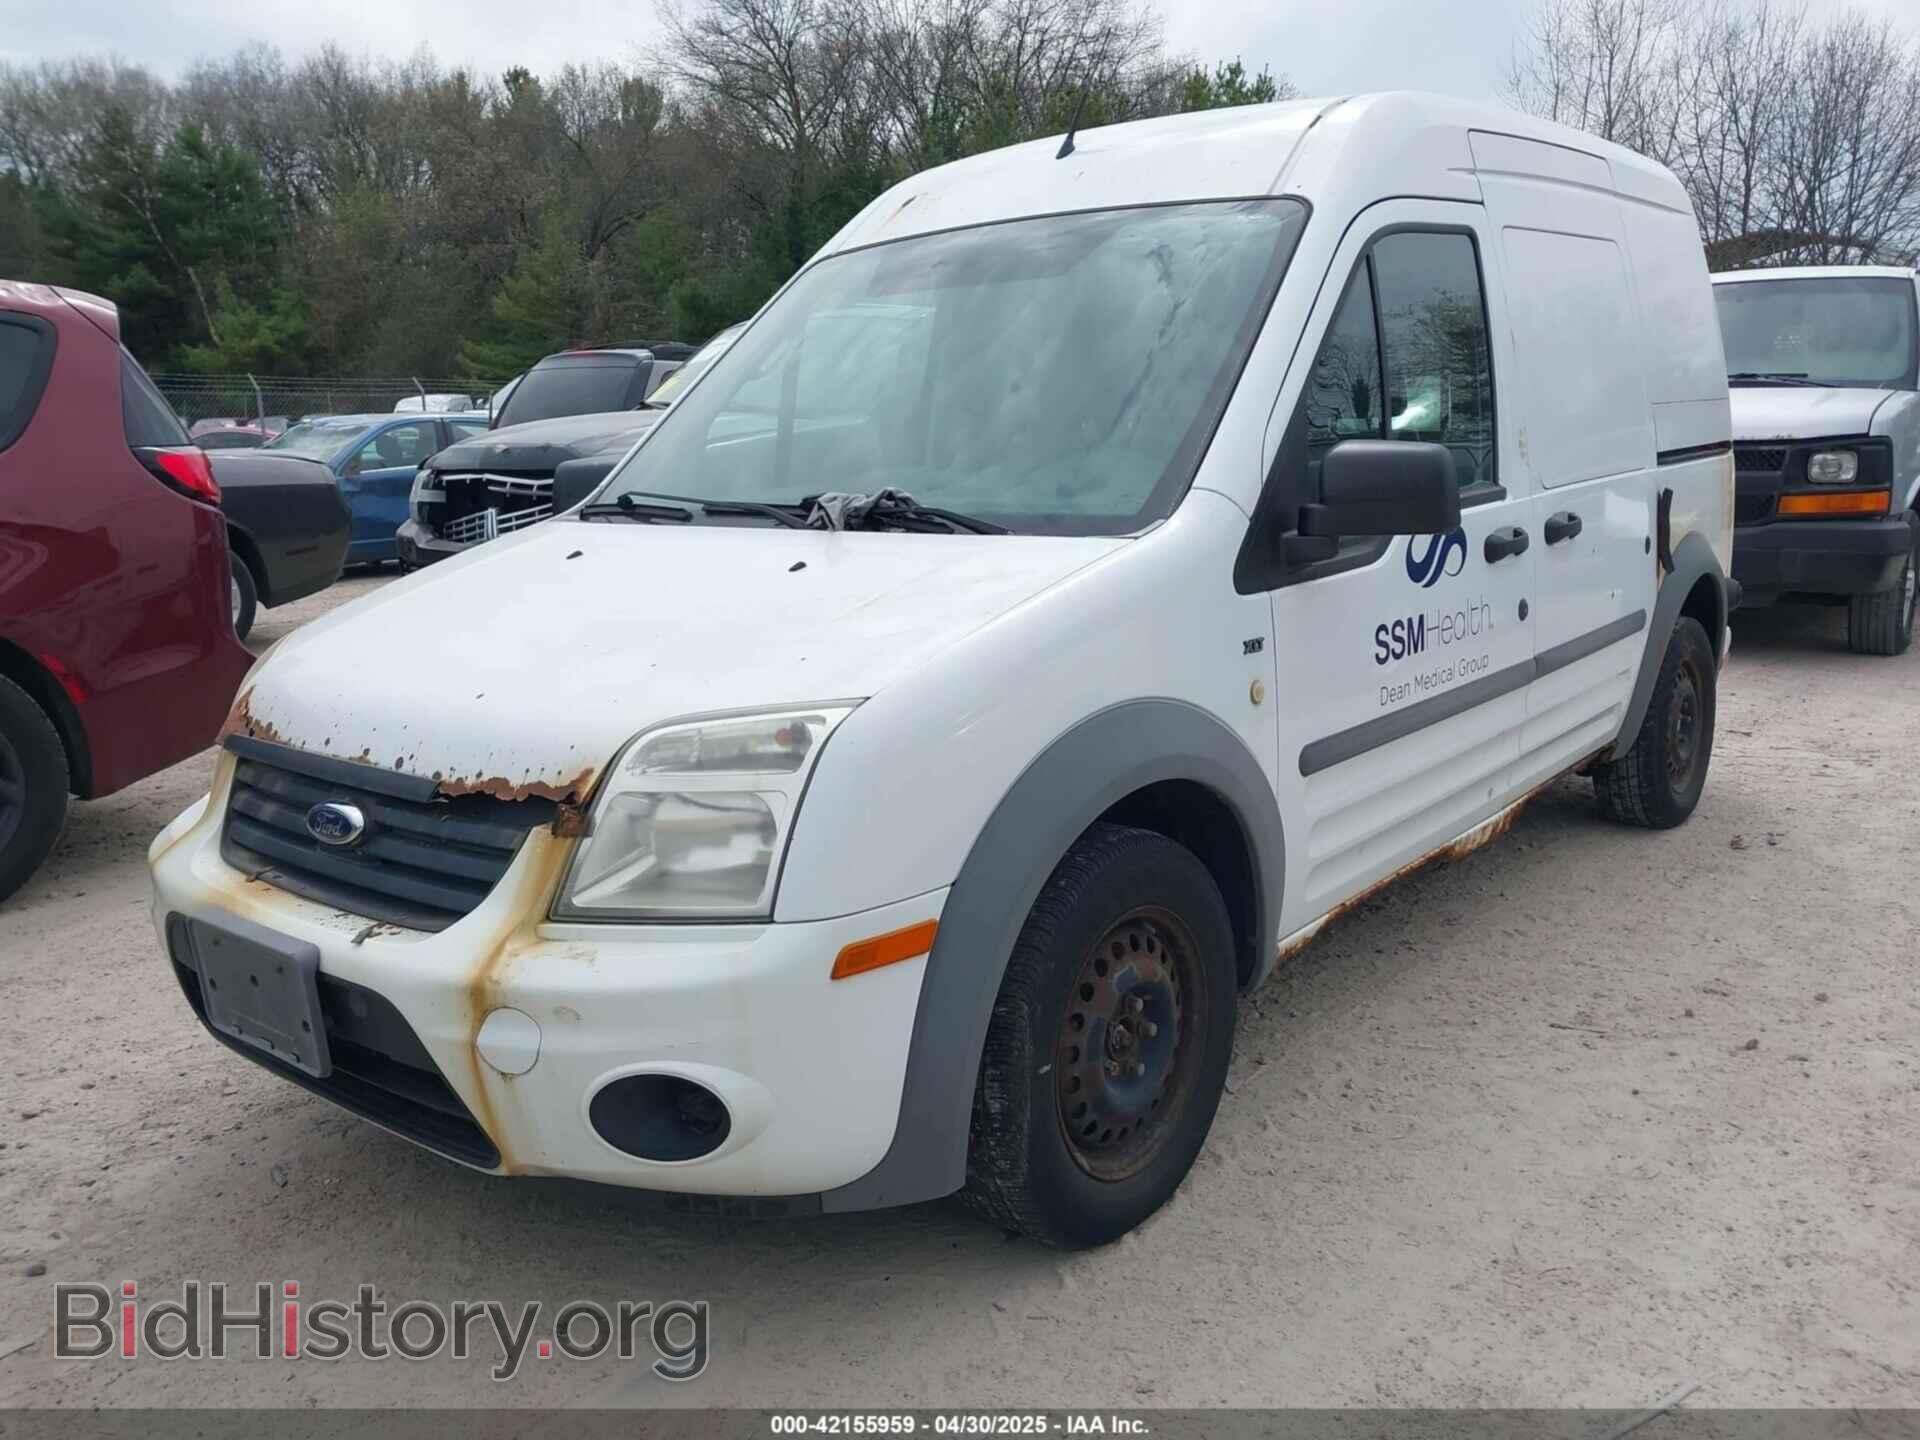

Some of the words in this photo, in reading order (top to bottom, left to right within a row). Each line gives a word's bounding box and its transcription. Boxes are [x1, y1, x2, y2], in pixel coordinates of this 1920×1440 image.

[1380, 682, 1411, 706] Dean
[1414, 661, 1456, 692] Medical
[1458, 654, 1489, 677] Group
